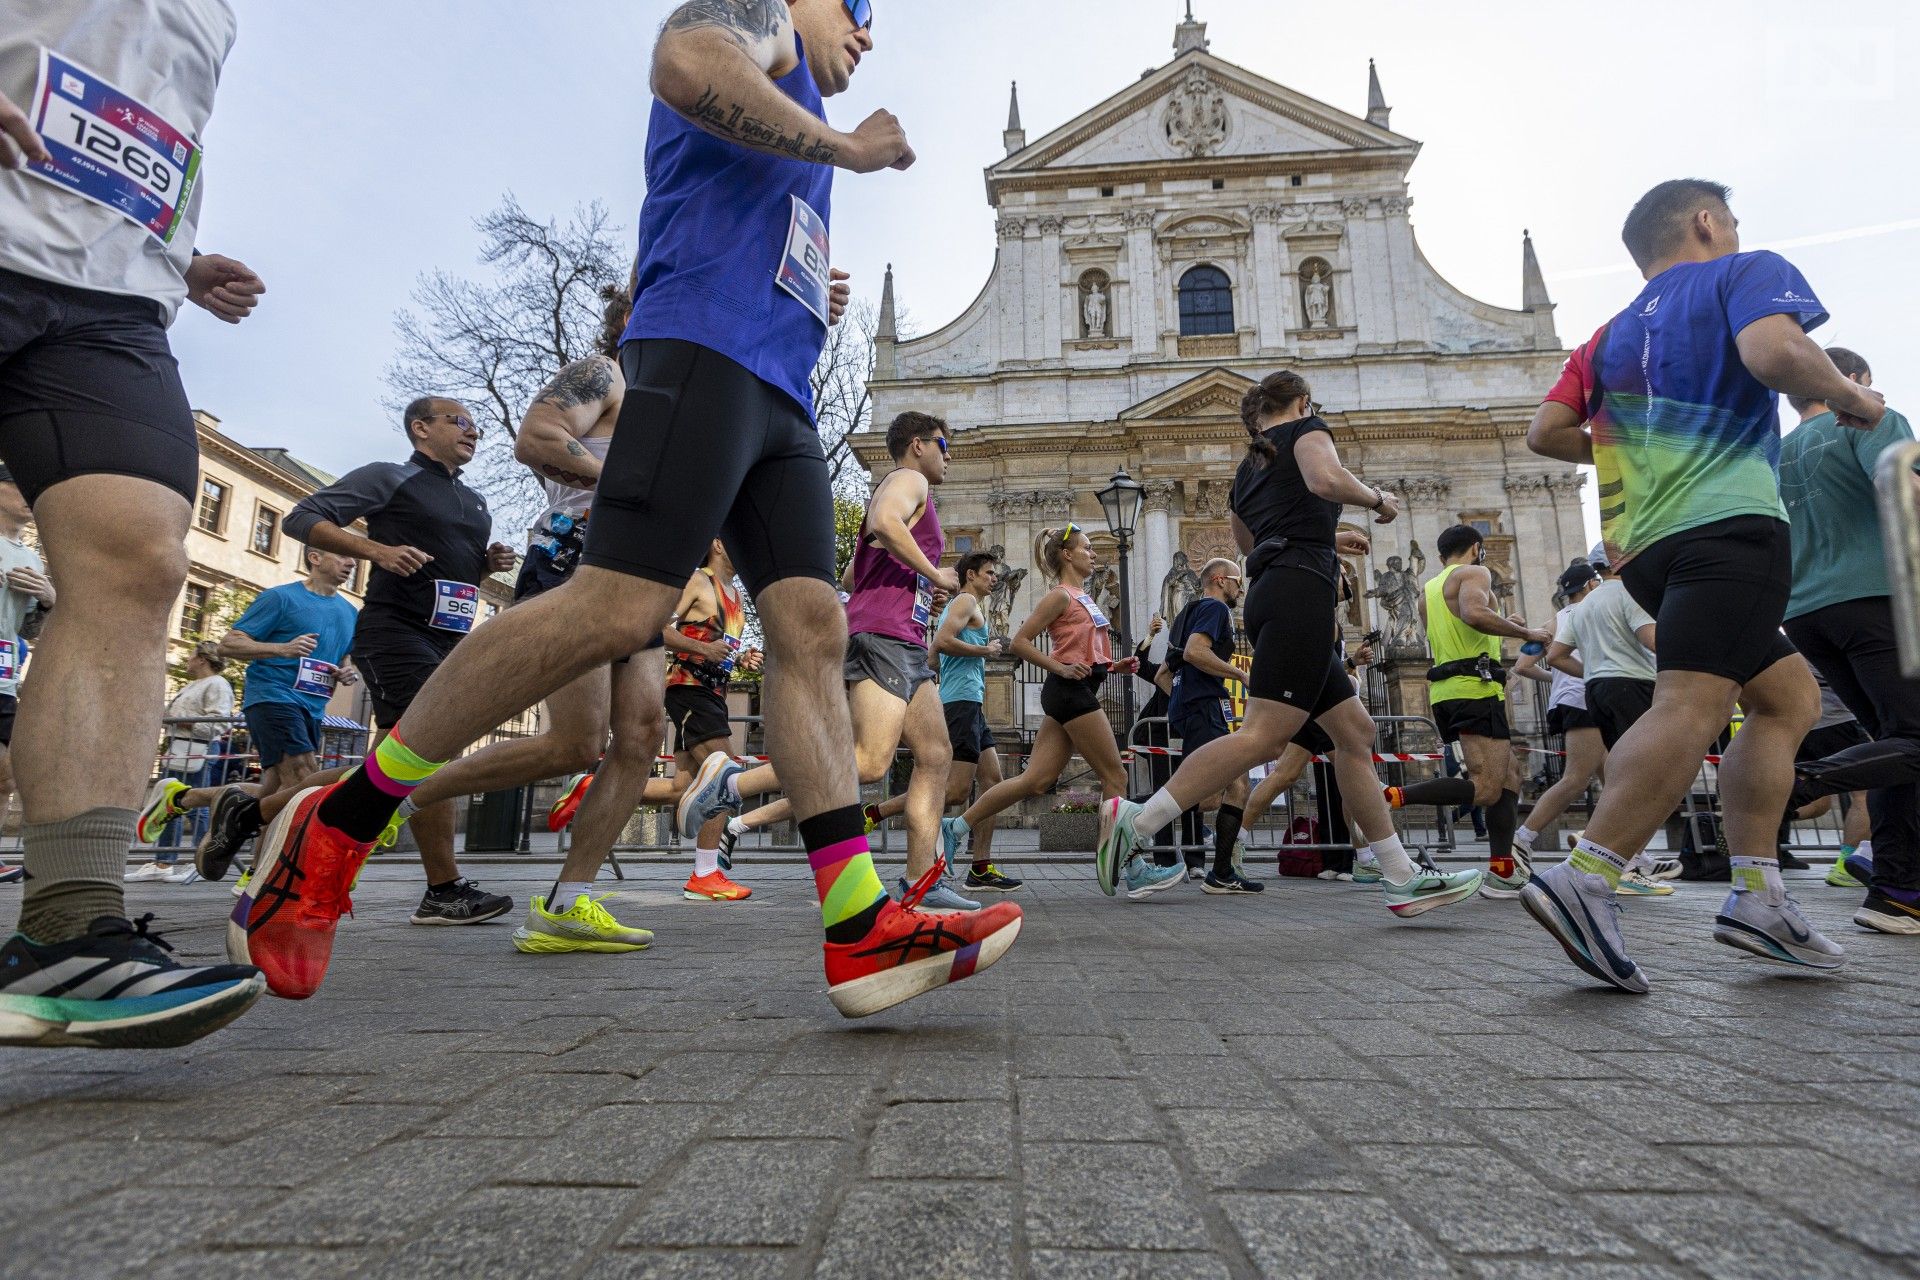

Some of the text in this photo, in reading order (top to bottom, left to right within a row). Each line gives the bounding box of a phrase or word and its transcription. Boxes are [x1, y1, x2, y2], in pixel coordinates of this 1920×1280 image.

[740, 117, 778, 142] never
[775, 131, 805, 153] walk
[69, 112, 171, 193] 1269
[311, 672, 330, 685] 1311
[1588, 846, 1626, 868] KIPRUN
